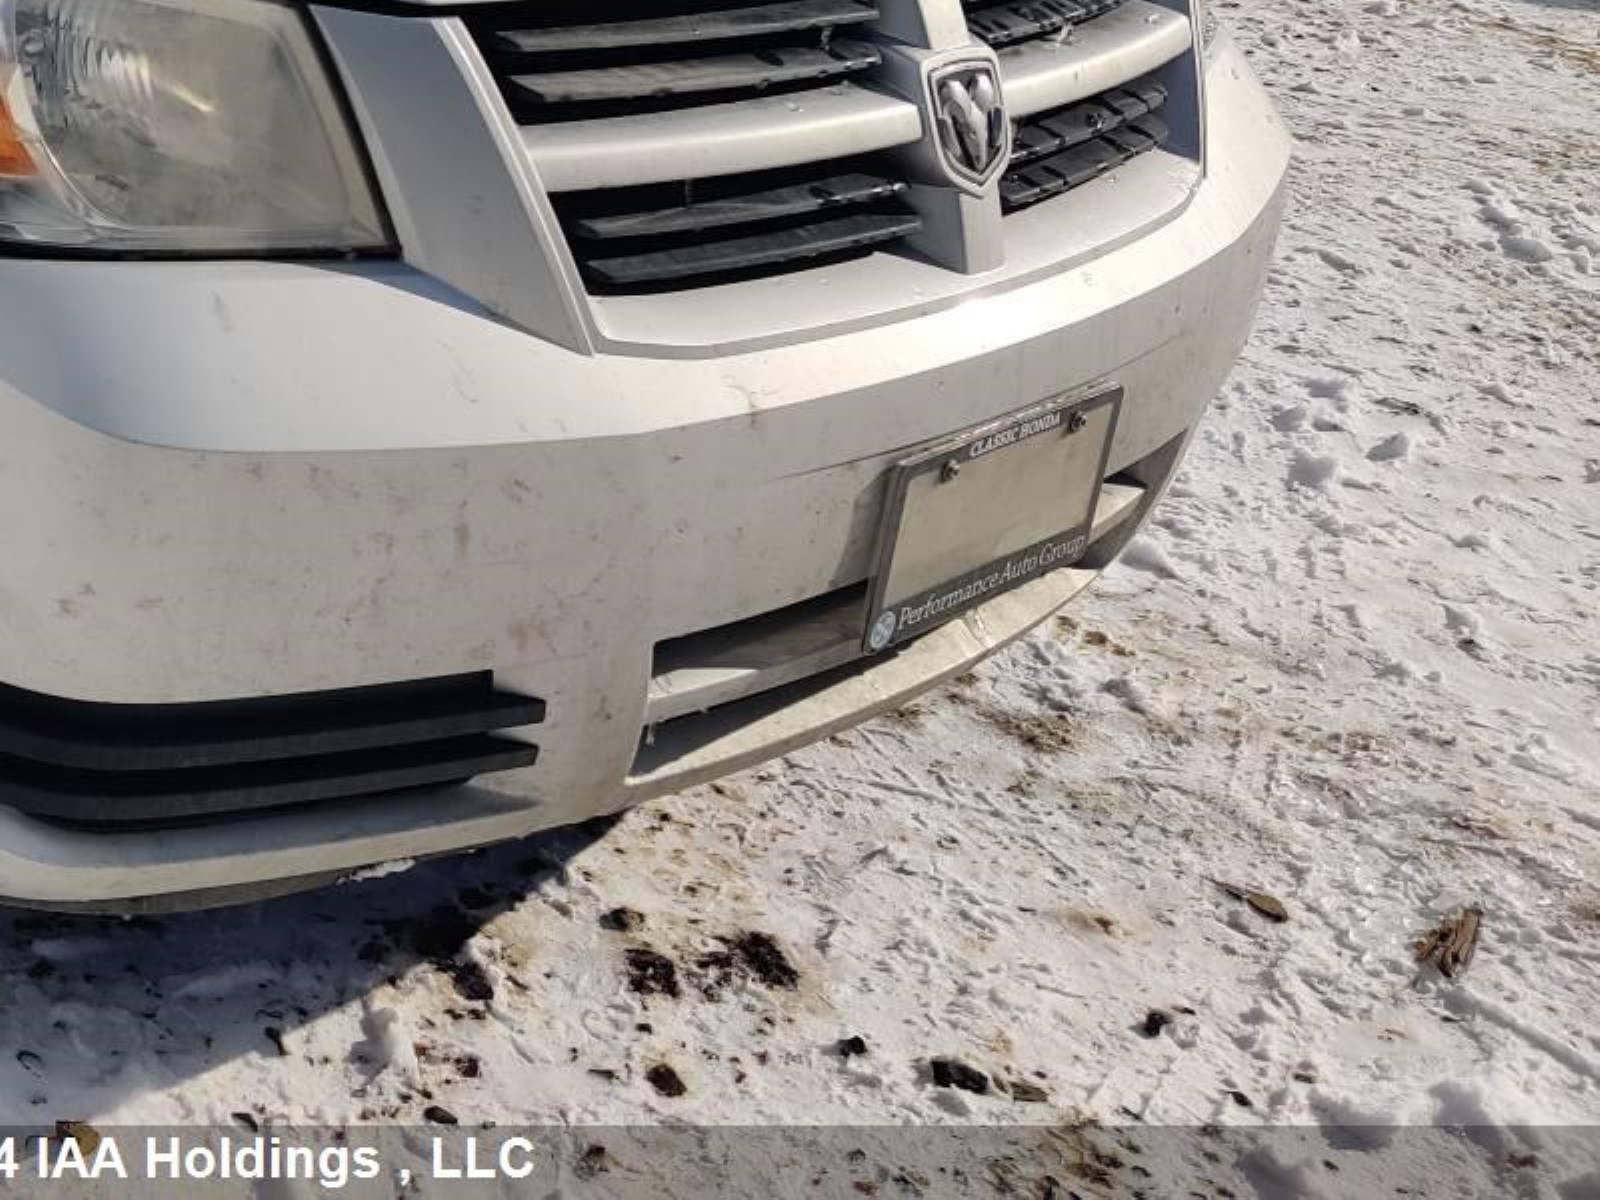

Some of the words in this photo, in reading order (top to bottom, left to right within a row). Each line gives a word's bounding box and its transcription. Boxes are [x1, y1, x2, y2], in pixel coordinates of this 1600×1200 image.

[970, 427, 1020, 457] CLASSIC
[1020, 411, 1060, 438] HONDA
[898, 576, 998, 630] Performance
[999, 557, 1038, 583] Auto
[1039, 535, 1086, 566] Group
